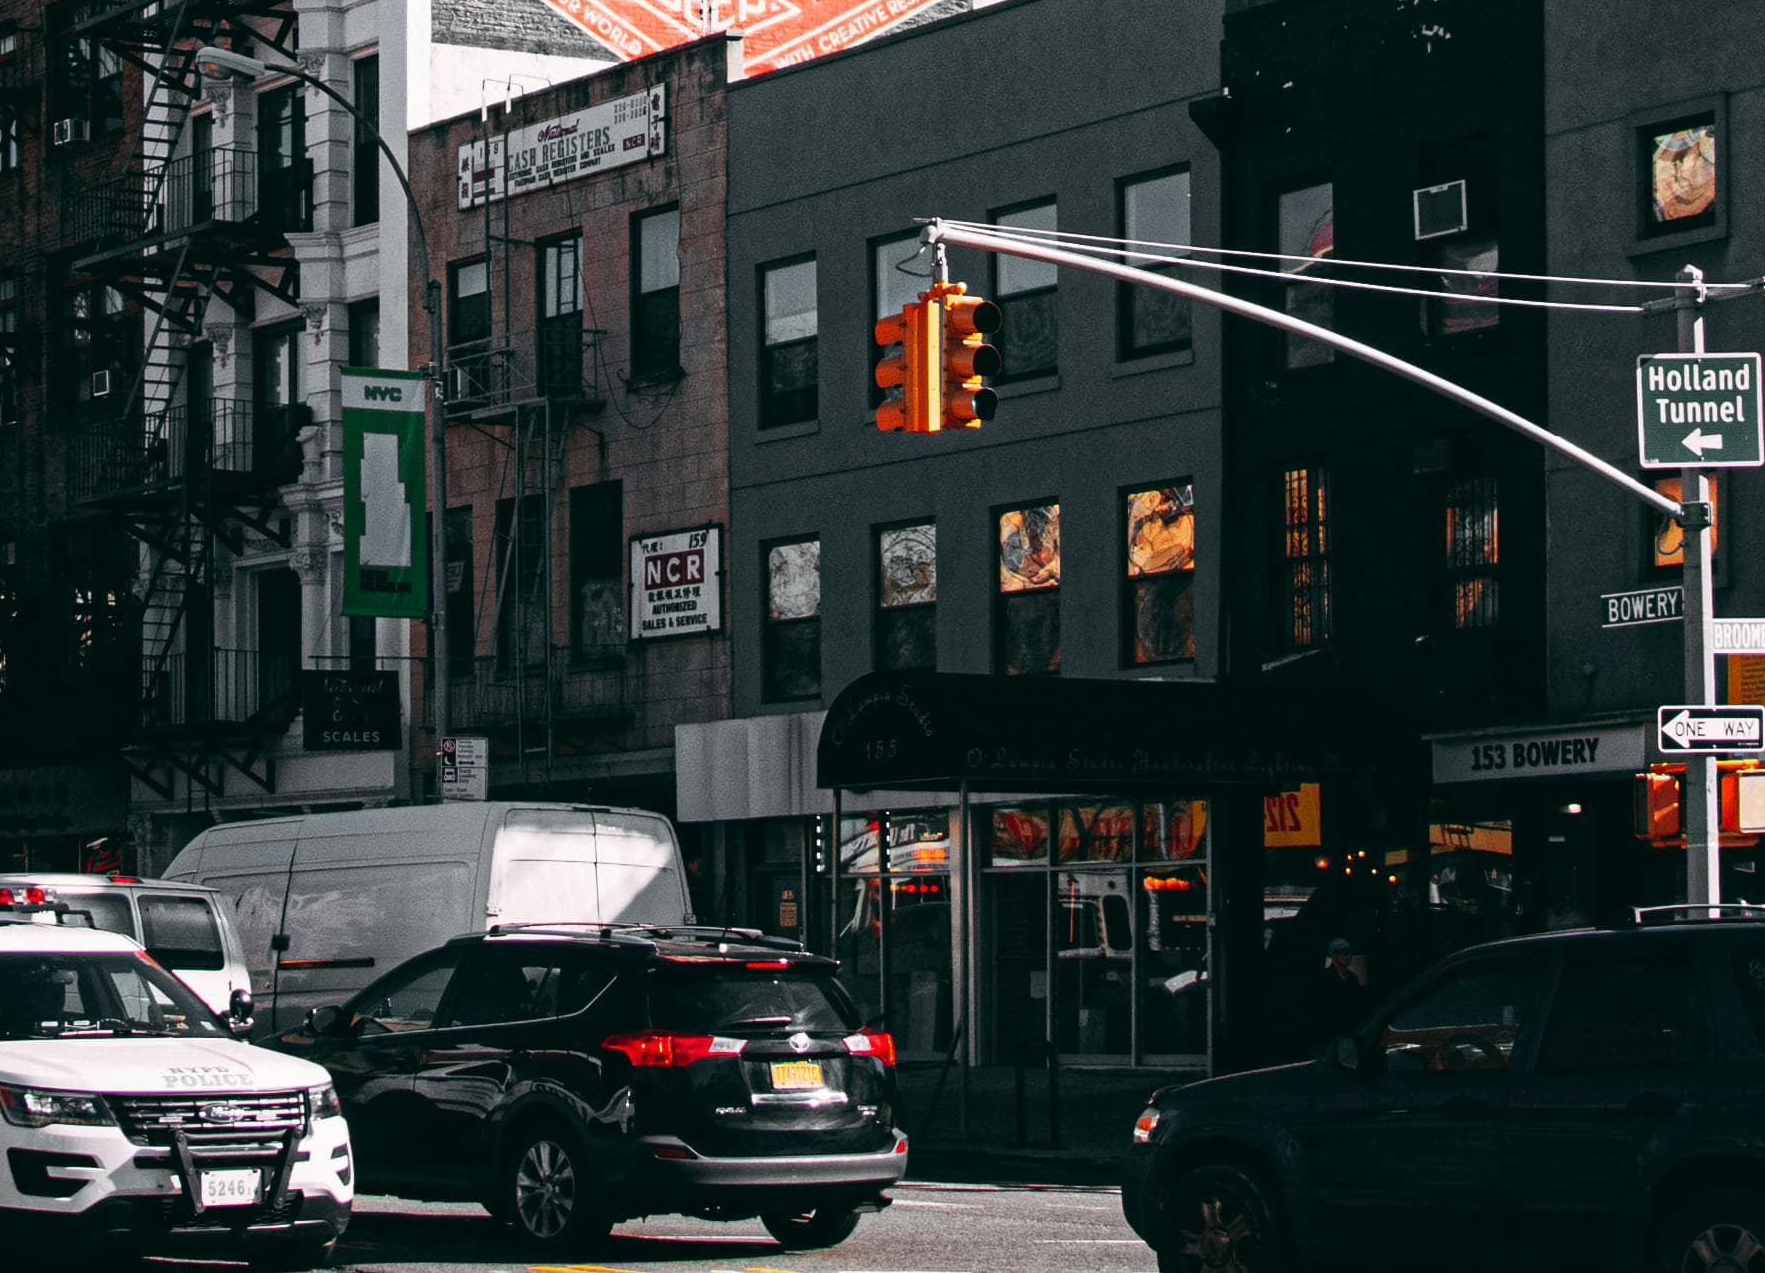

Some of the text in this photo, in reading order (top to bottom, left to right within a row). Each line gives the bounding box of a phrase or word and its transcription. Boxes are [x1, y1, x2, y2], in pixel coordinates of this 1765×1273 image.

[583, 6, 644, 55] WORLD
[819, 3, 887, 52] CREATIVE
[537, 118, 581, 143] National
[507, 125, 611, 173] CASH REGISTERS
[1648, 364, 1751, 392] Holland
[364, 384, 403, 403] NYC
[1655, 398, 1746, 425] Tunnel
[689, 532, 708, 549] 159
[646, 553, 701, 586] NCR
[652, 600, 697, 615] AUTHORIZED
[1608, 591, 1679, 623] BOWERY
[642, 613, 708, 631] SALES & SERVICE
[323, 730, 381, 744] SCALES
[1674, 720, 1756, 738] ONE WAY
[865, 738, 898, 761] 155
[1470, 736, 1600, 772] 153 BOWERY
[162, 1073, 254, 1088] POLICE
[167, 1066, 230, 1074] NYPD
[208, 1179, 245, 1197] 5246
